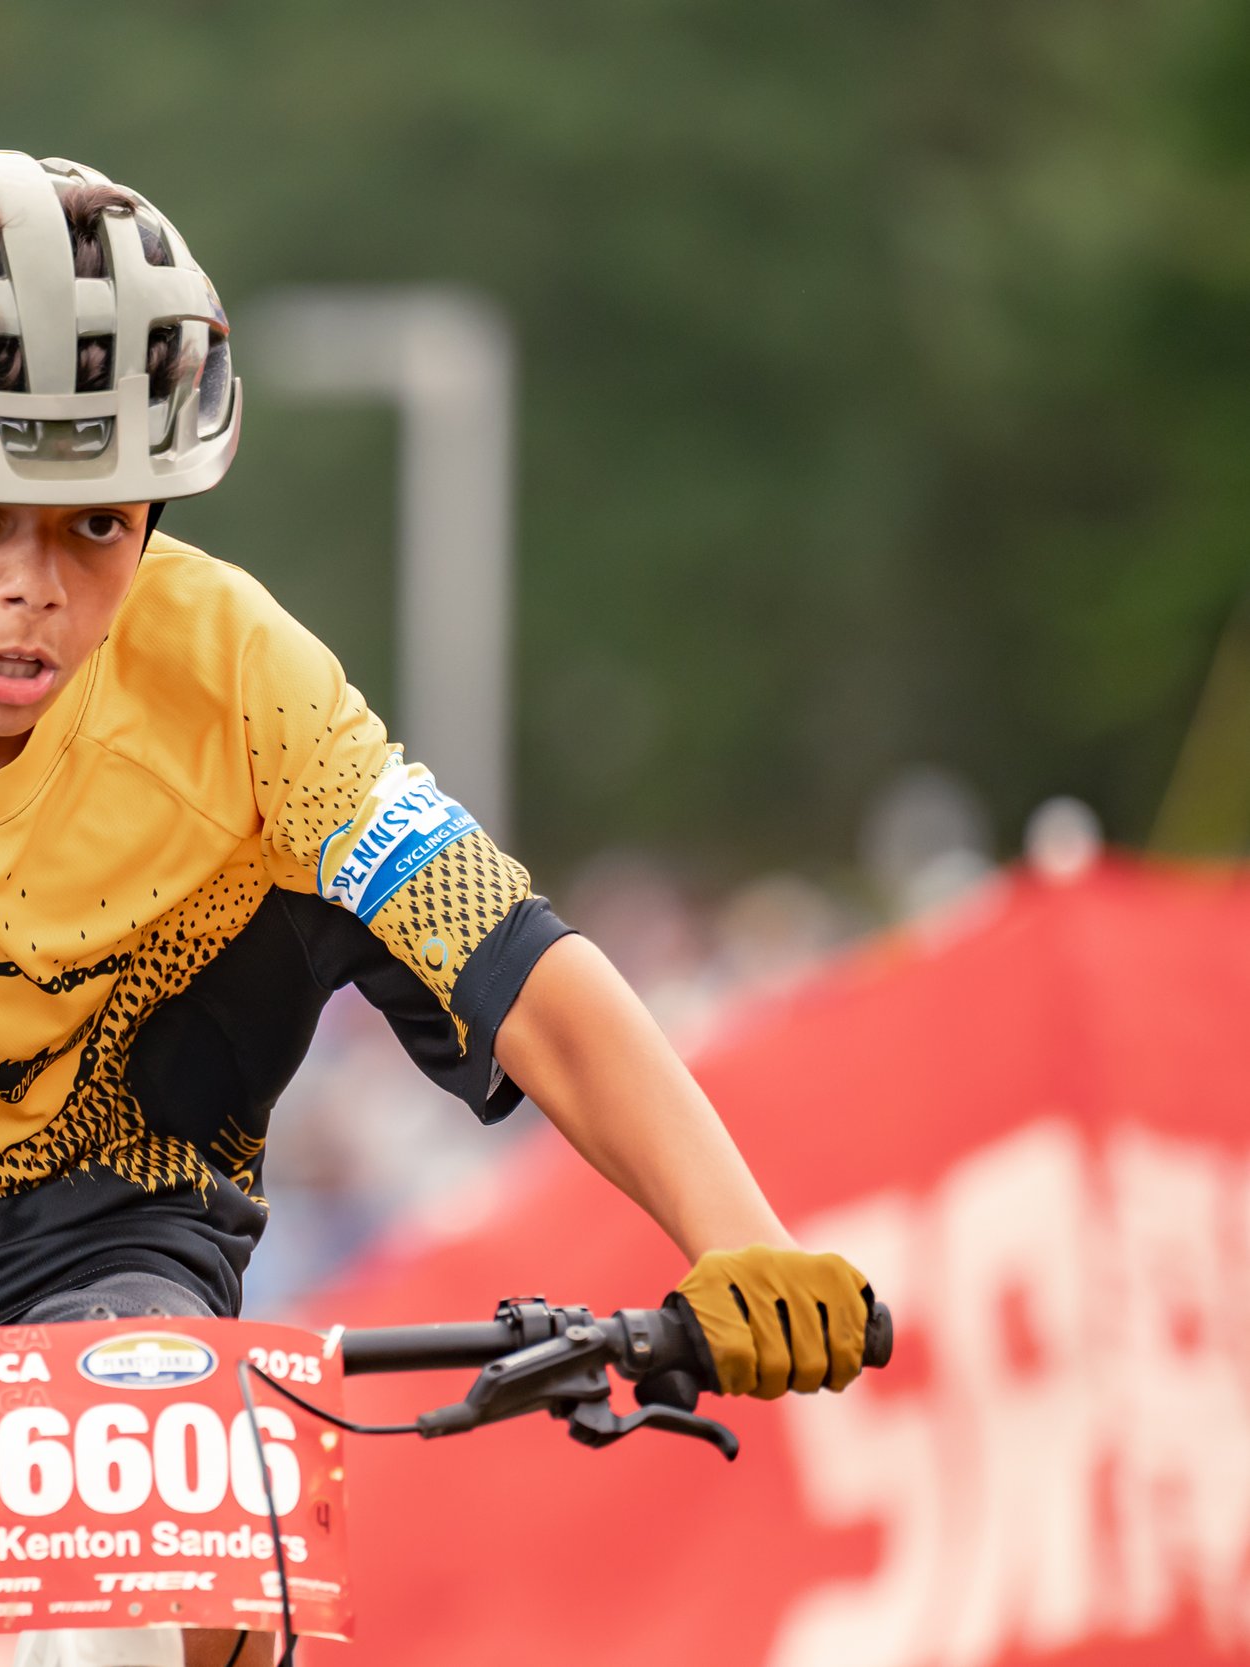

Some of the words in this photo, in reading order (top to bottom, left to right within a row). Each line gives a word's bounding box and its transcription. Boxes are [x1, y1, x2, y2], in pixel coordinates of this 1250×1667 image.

[395, 828, 450, 873] CYCLING
[249, 1347, 322, 1383] 2025
[93, 1571, 217, 1592] TREK
